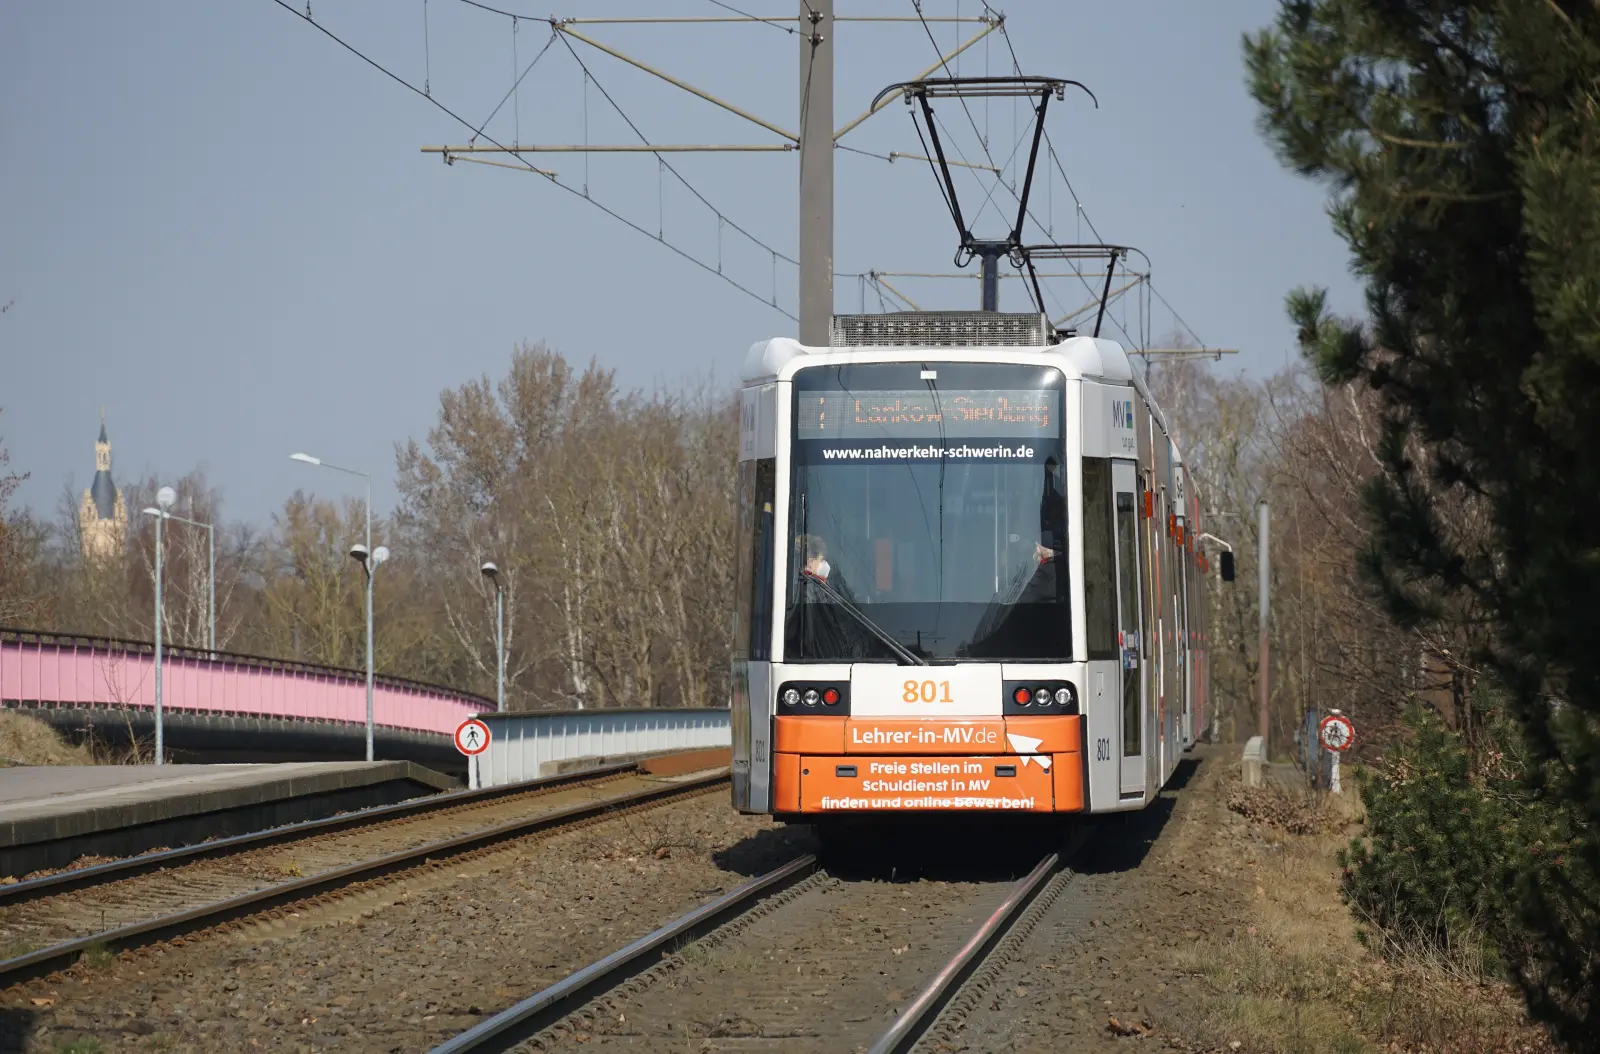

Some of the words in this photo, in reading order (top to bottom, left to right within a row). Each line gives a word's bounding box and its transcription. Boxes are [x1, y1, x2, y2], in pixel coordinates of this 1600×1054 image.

[1112, 399, 1125, 429] MV
[822, 445, 1034, 459] www.nahverkehr-schwerin.de
[902, 680, 954, 703] 801
[852, 727, 997, 744] Lehrer-in-MV.de
[1097, 738, 1110, 761] 801
[870, 761, 907, 774] Freie
[910, 762, 960, 774] Stellen
[963, 761, 982, 774] im
[862, 779, 948, 791] Schuldienst
[951, 779, 965, 791] in
[968, 780, 991, 791] MV
[821, 797, 868, 809] finden
[871, 797, 901, 808] und
[903, 797, 951, 808] online
[954, 797, 1034, 809] bewerben!
